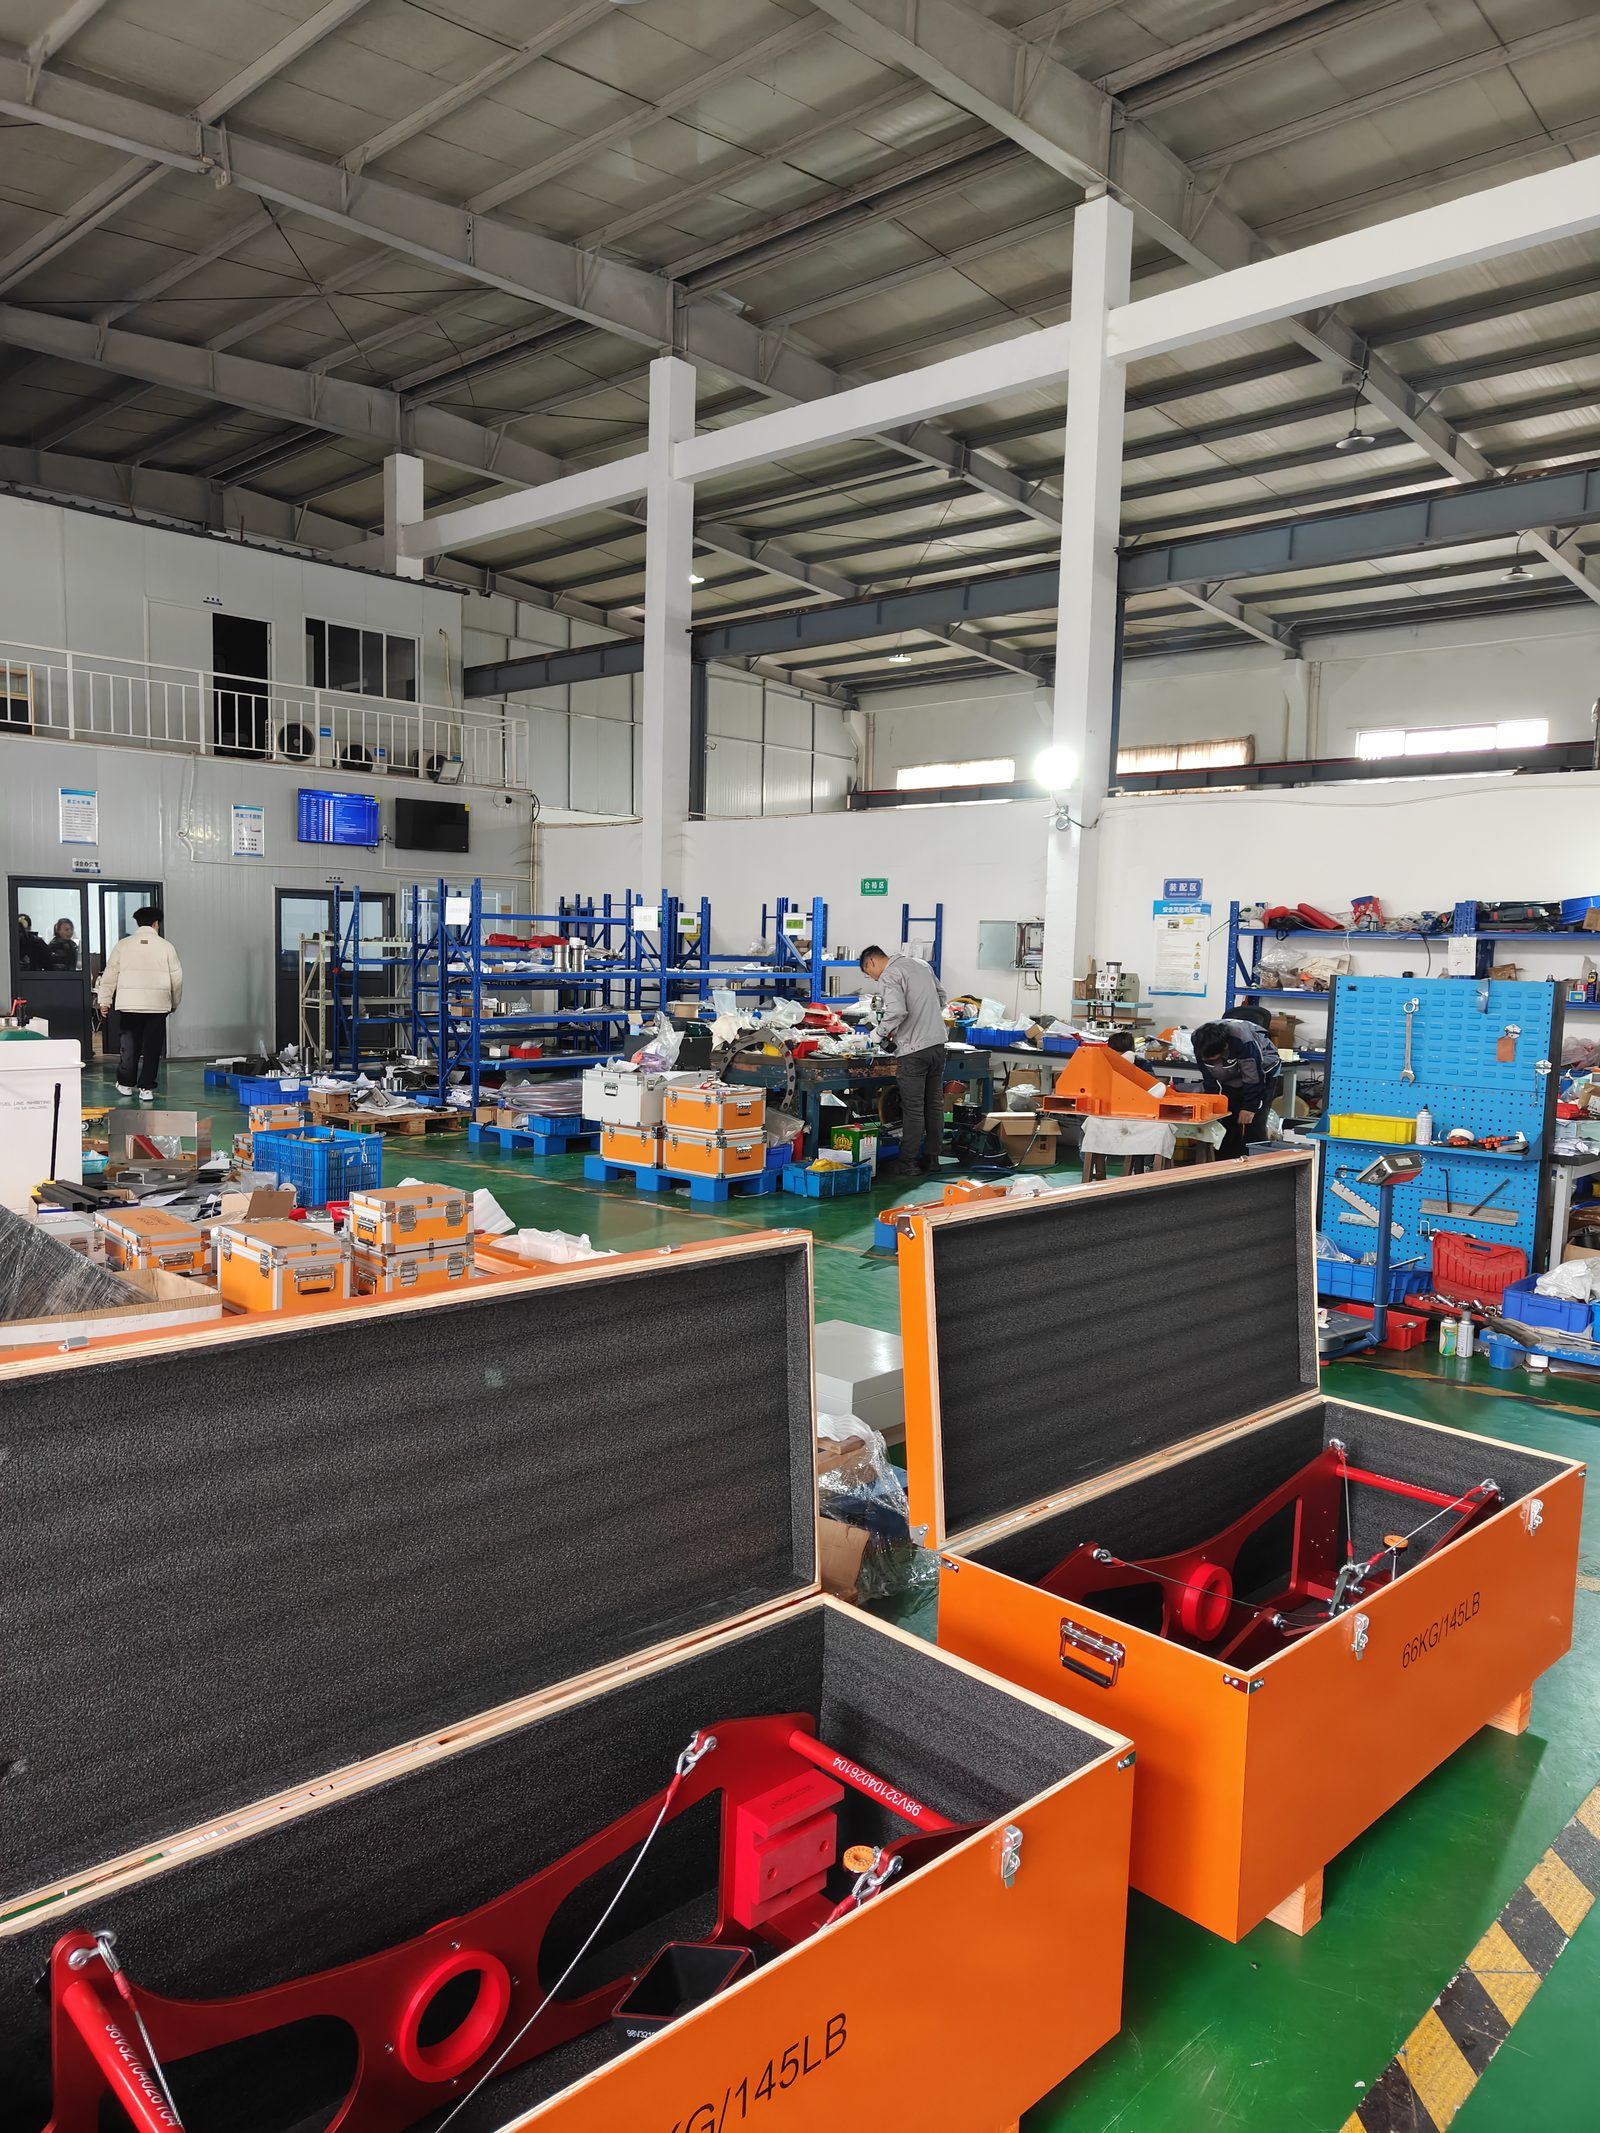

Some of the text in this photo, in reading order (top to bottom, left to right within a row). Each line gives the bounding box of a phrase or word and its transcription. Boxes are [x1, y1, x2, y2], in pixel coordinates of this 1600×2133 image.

[1168, 882, 1197, 892] 装配区
[1402, 1591, 1480, 1668] 66KG/145LB
[832, 1756, 922, 1817] 98V32104026104
